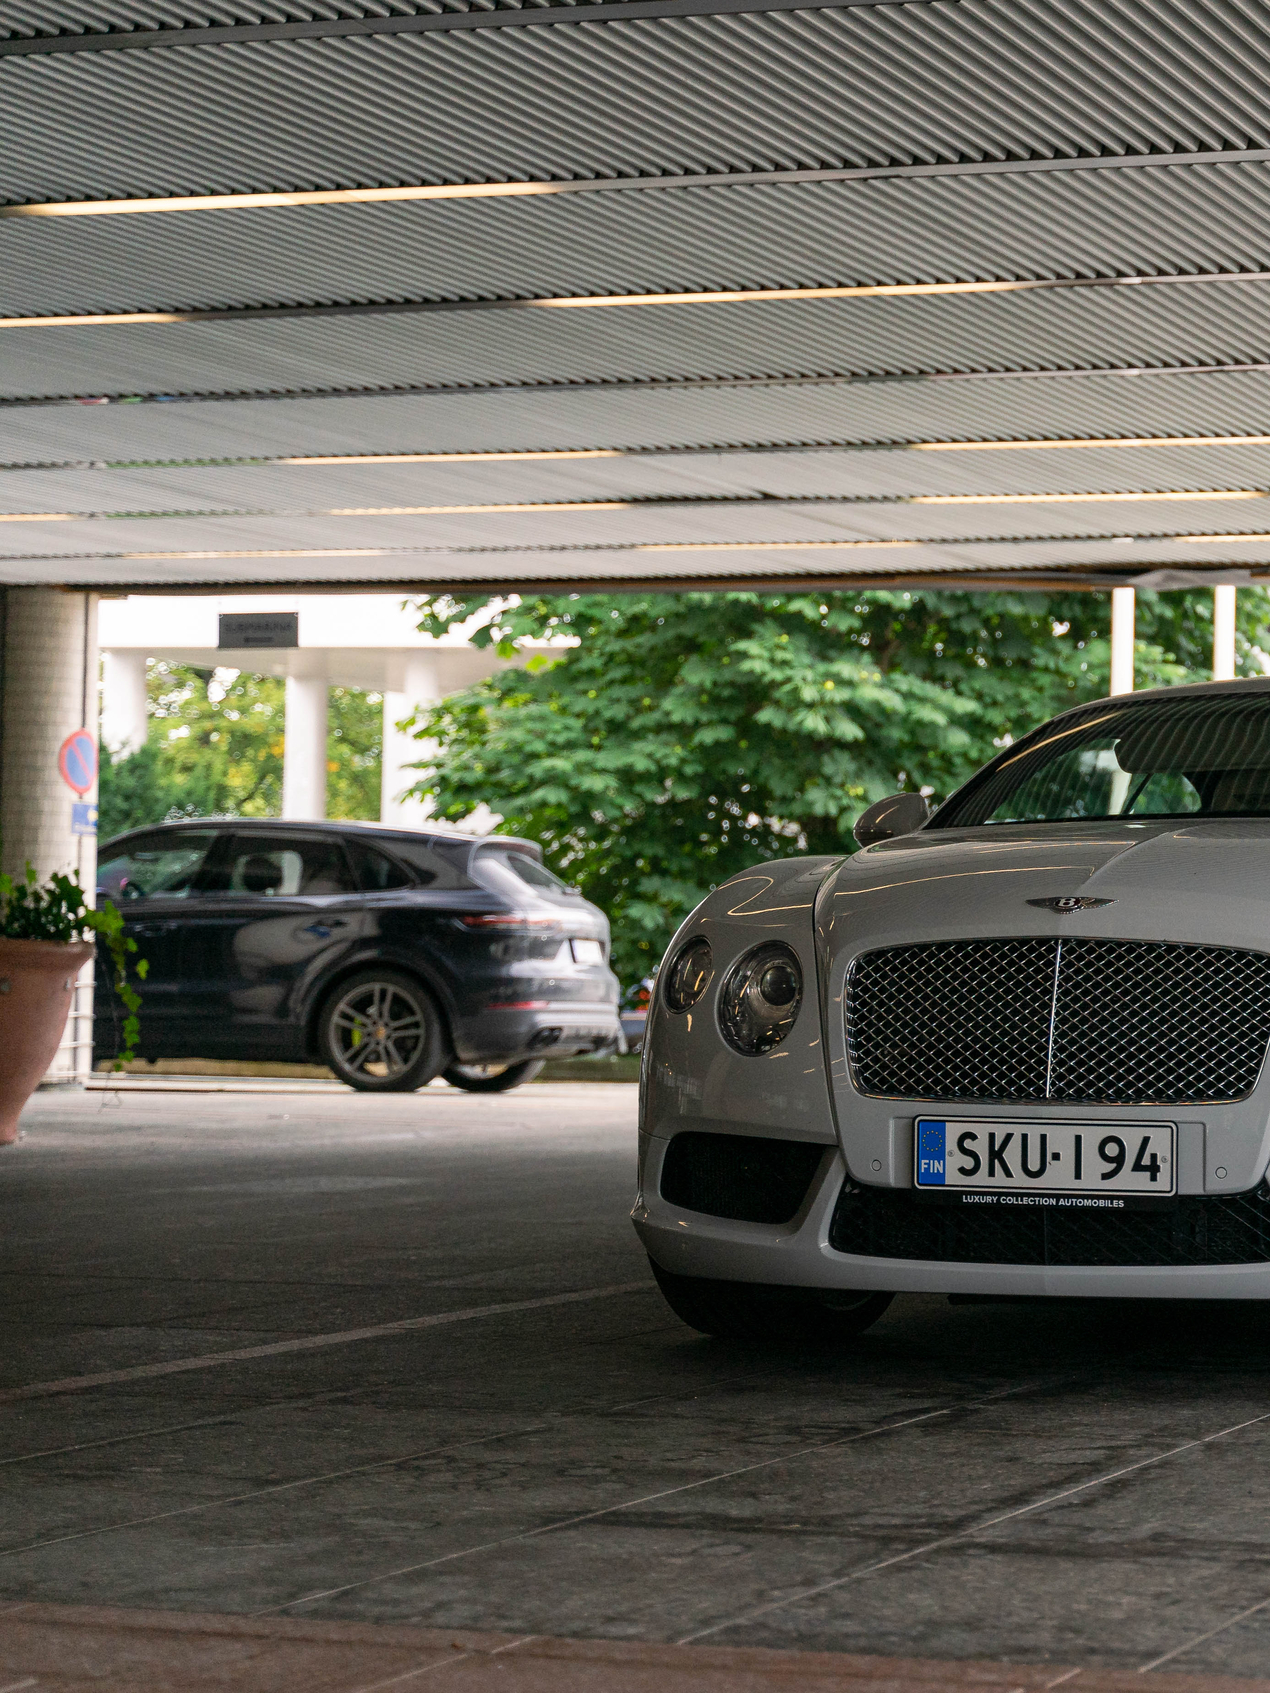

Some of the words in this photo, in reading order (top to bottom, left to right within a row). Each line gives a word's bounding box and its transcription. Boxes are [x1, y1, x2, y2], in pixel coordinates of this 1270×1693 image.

[956, 1130, 1162, 1182] SKU-194
[921, 1158, 944, 1174] FIN
[962, 1195, 998, 1205] LUXURY
[1000, 1195, 1056, 1207] COLLECTION
[1058, 1196, 1125, 1208] AUTOMOBILES
